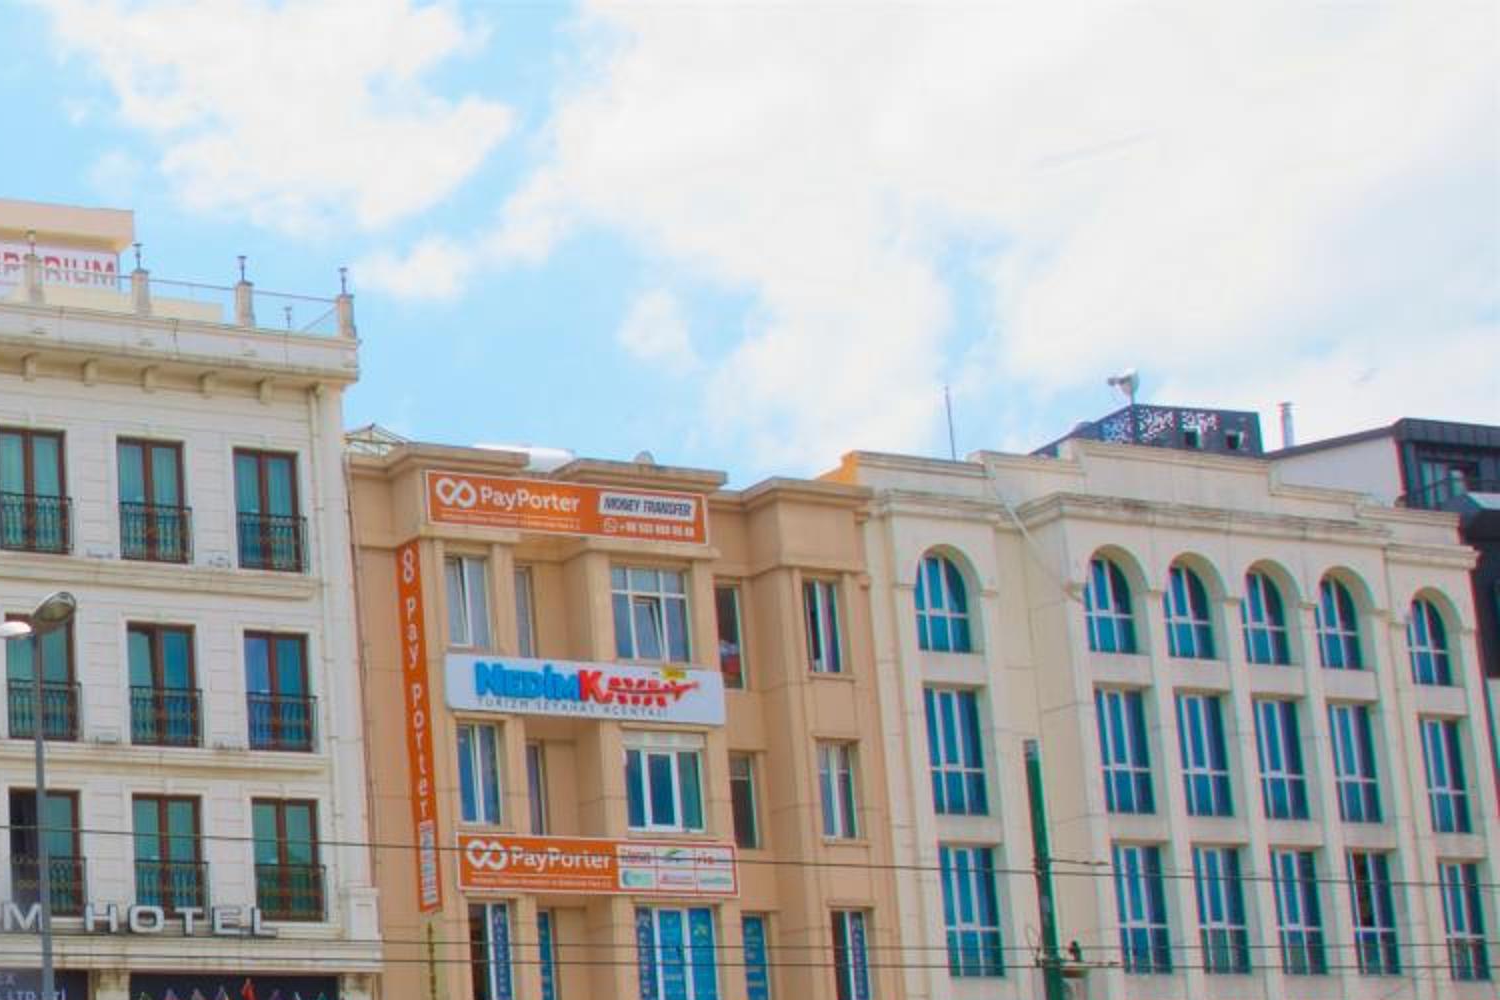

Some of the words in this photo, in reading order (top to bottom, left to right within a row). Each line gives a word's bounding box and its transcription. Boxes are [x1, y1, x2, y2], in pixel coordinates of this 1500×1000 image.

[480, 485, 580, 513] PayPorter
[510, 846, 613, 873] PayPorter
[85, 902, 277, 937] HOTEL
